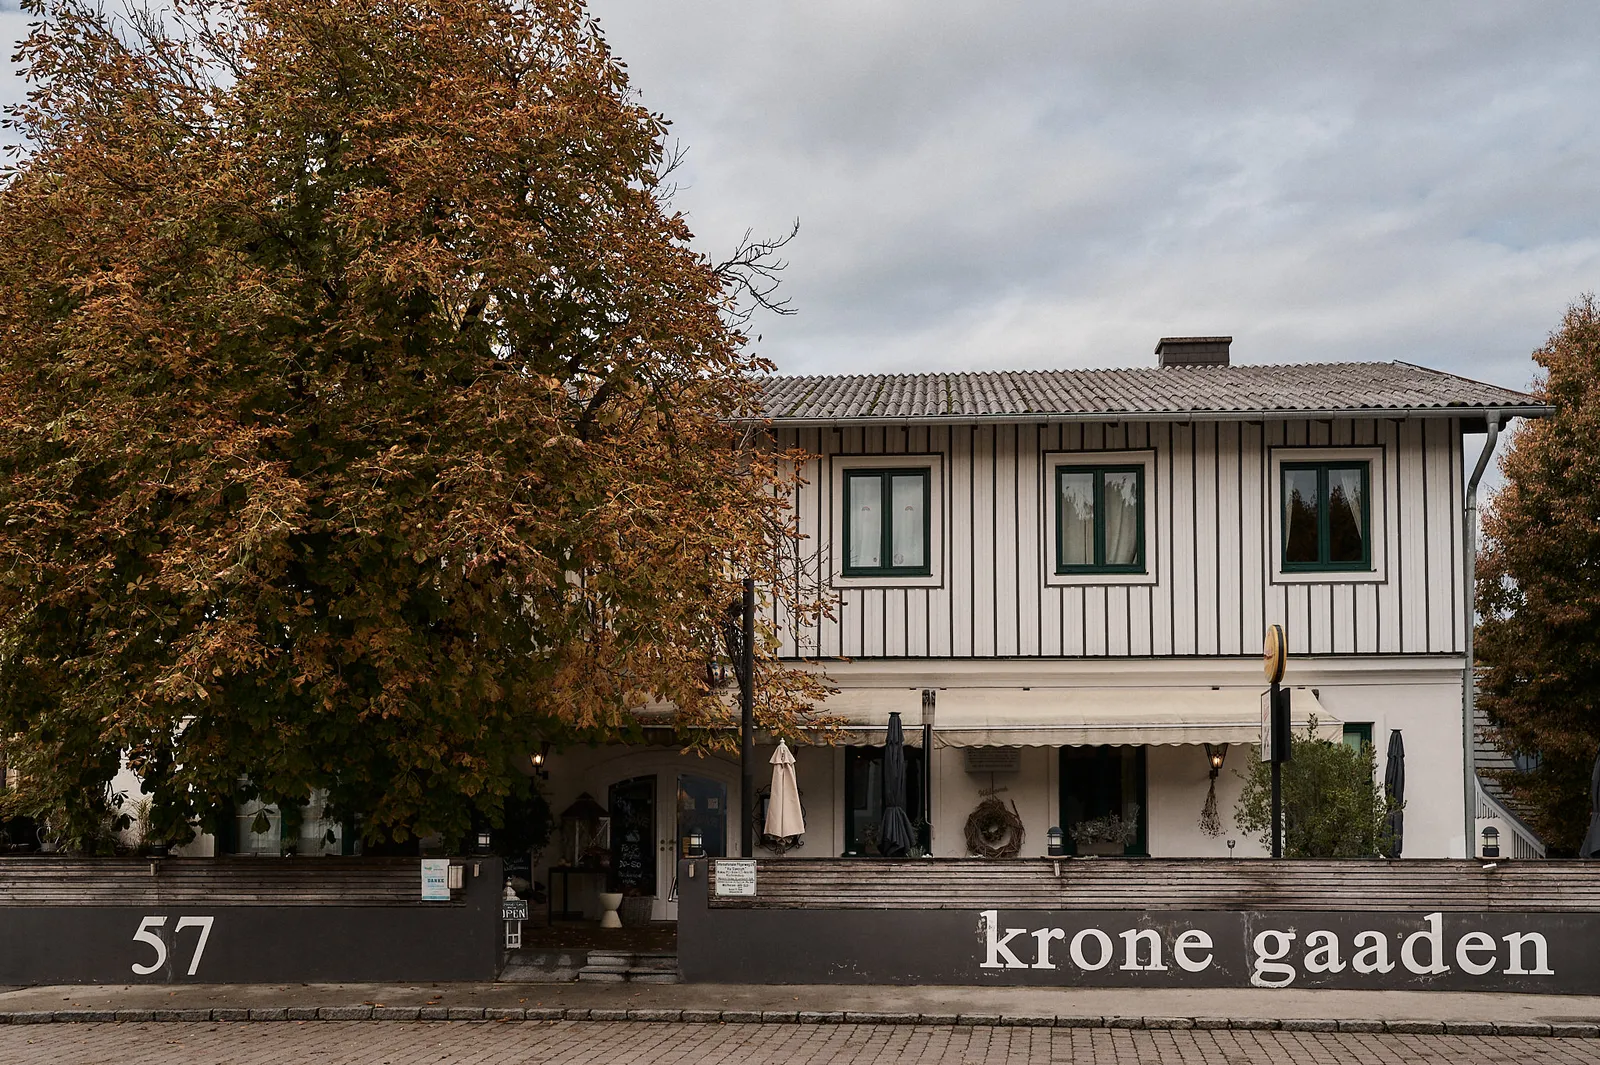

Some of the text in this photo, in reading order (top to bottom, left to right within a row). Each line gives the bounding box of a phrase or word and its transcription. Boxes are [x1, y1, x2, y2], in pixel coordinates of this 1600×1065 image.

[131, 916, 214, 975] 57
[980, 910, 1555, 988] krone gaaden
